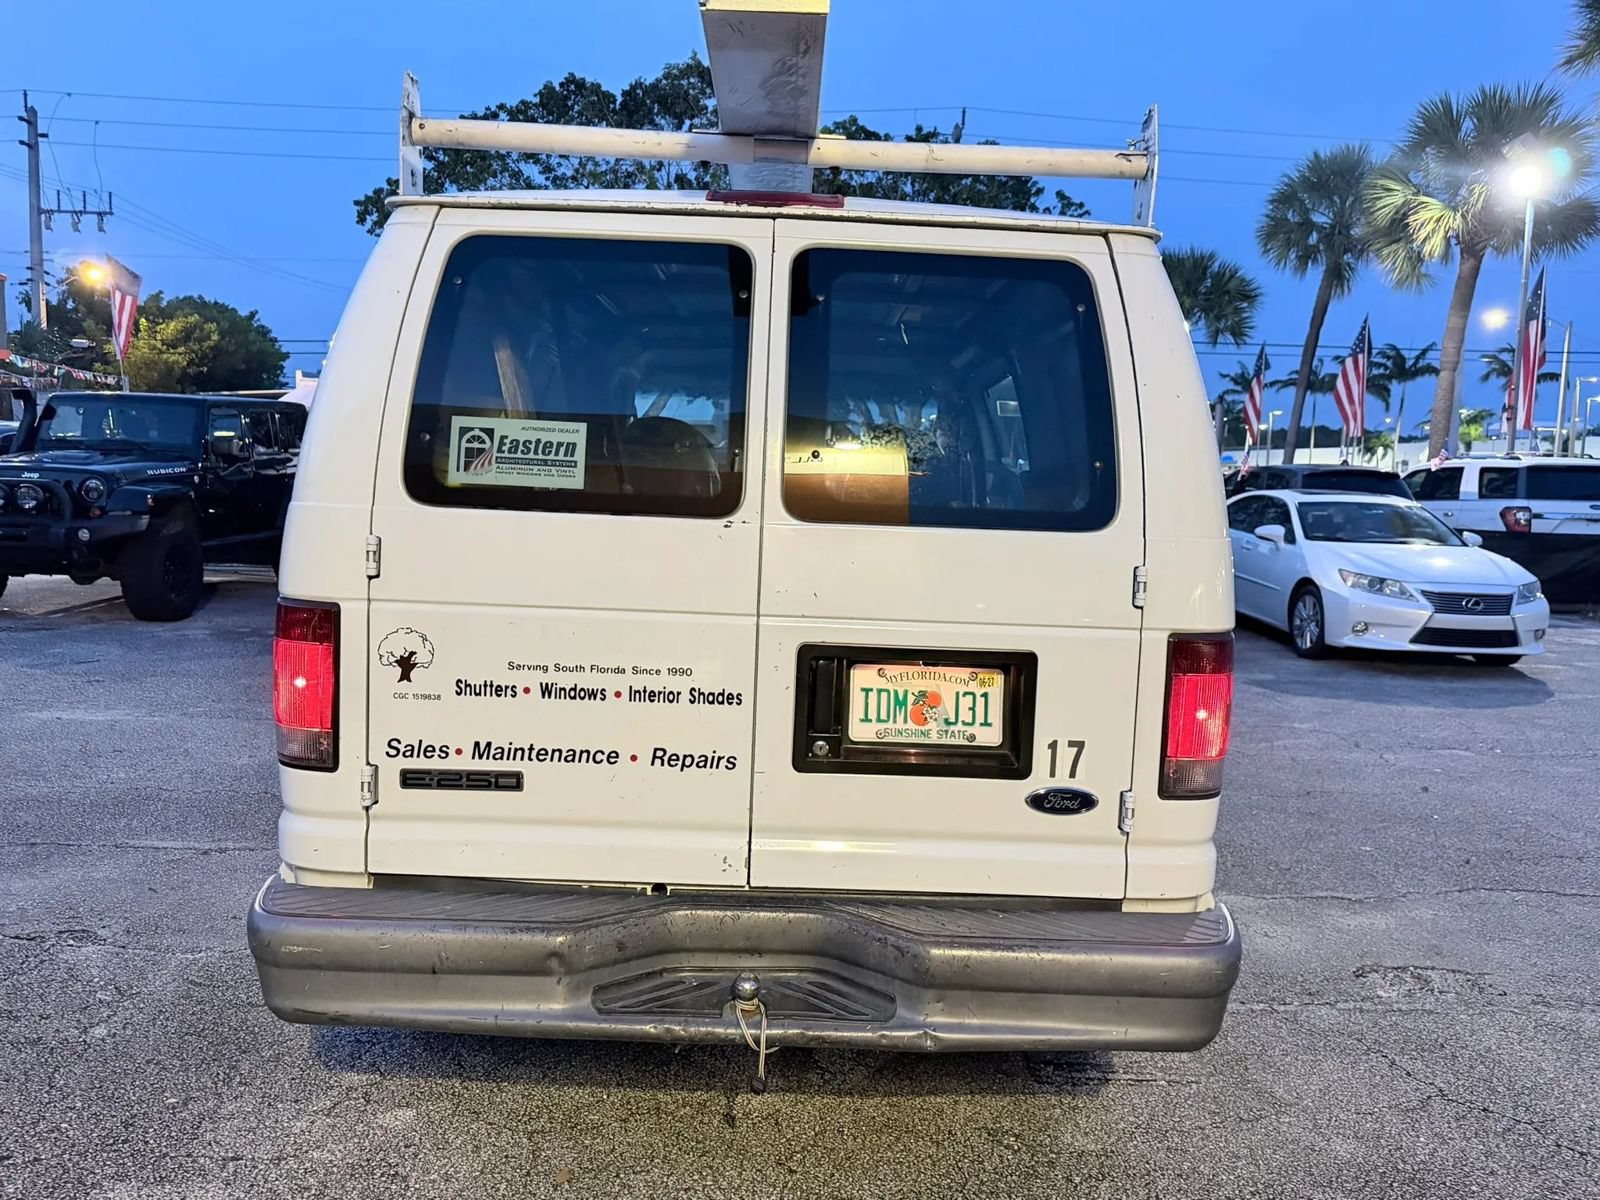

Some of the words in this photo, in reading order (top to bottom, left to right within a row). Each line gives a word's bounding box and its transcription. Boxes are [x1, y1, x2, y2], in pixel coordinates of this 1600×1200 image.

[496, 435, 577, 458] Eastern
[147, 466, 186, 475] RUBICON
[496, 458, 545, 466] ARCHITECTURAL
[21, 471, 39, 479] Jeep
[507, 661, 549, 673] Serving
[553, 663, 585, 673] South
[590, 664, 626, 675] Florida
[631, 666, 661, 676] Since
[667, 667, 693, 677] 1990
[885, 670, 970, 688] MYFLORIDA.COM
[393, 692, 409, 700] CGC
[412, 693, 442, 701] 1519838
[455, 678, 518, 698] Shutters
[539, 682, 607, 701] Windows
[628, 685, 682, 704] Interior
[688, 687, 743, 706] Shades
[859, 687, 909, 724] IDM
[943, 690, 993, 728] J31
[884, 727, 932, 739] SUNSHINE
[936, 729, 968, 740] STATE
[385, 738, 450, 760] Sales
[471, 740, 620, 765] Maintenance
[650, 747, 737, 772] Repairs
[1047, 739, 1086, 779] 17
[1043, 792, 1081, 810] Ford
